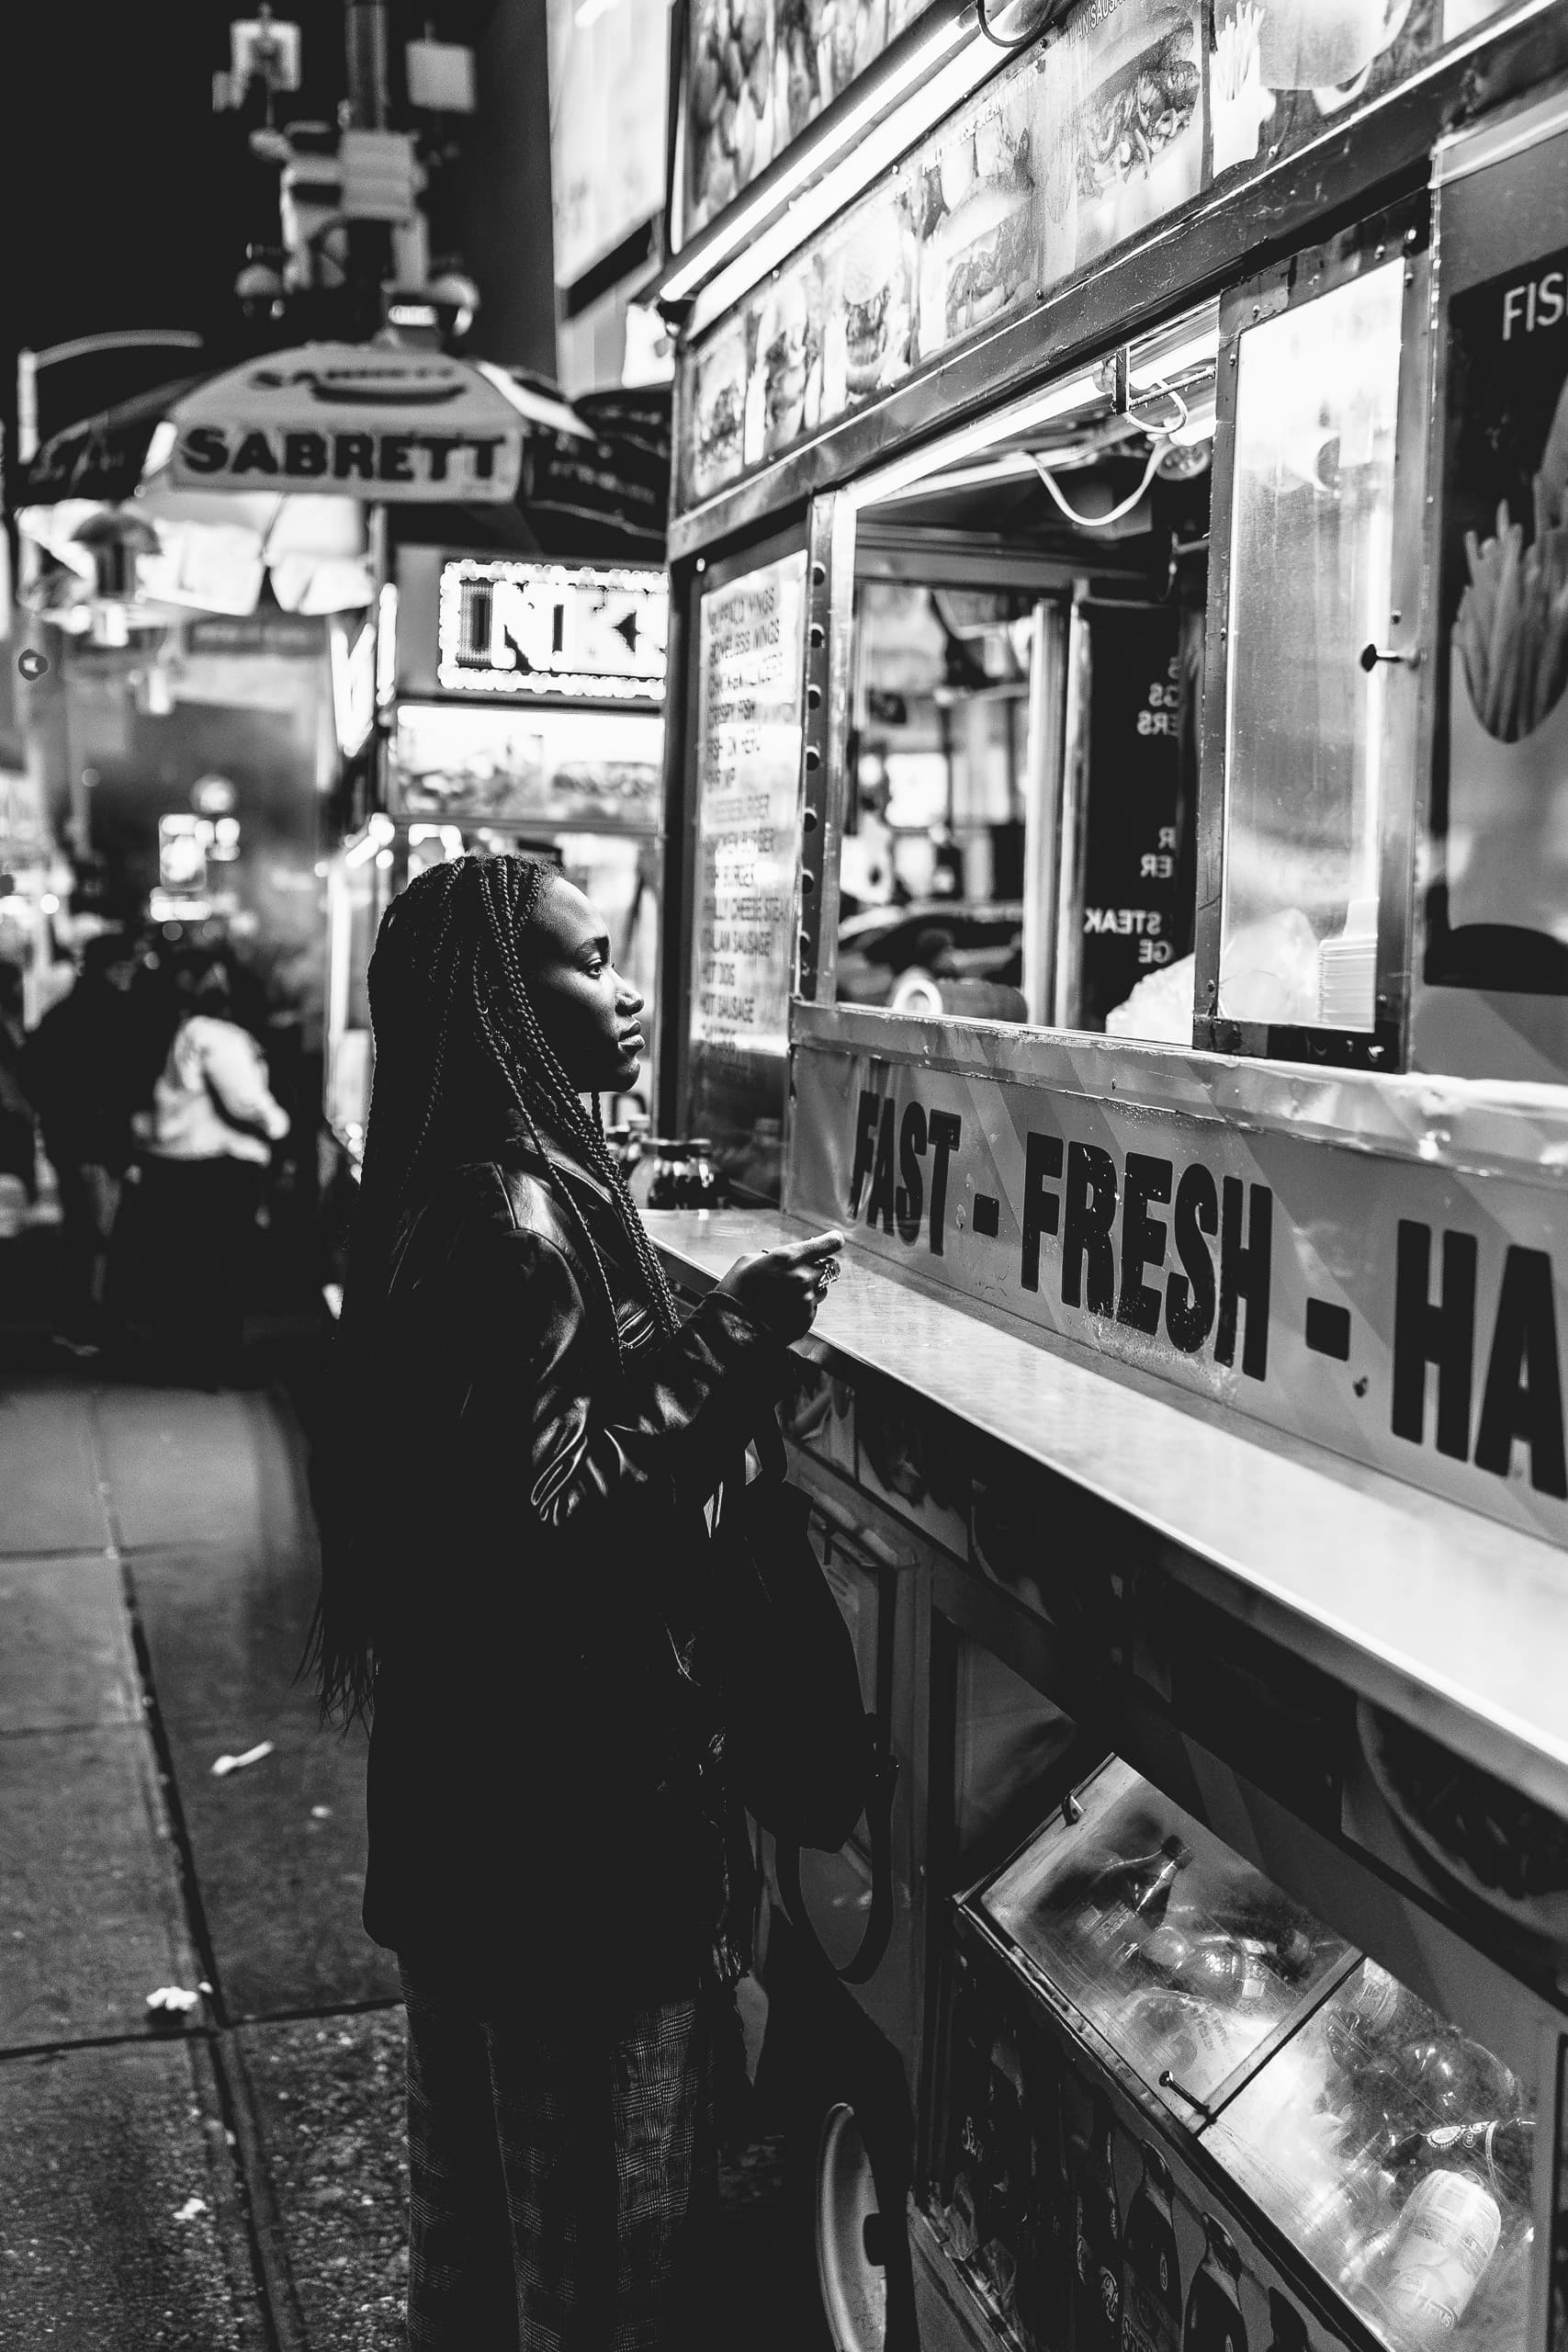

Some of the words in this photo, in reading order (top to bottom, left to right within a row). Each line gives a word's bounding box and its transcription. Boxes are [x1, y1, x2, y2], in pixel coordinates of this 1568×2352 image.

[1502, 271, 1568, 341] FIS
[186, 426, 506, 481] SABRETT
[849, 1091, 961, 1257] FAST
[1020, 1132, 1274, 1383] FRESH
[1391, 1218, 1568, 1501] HA
